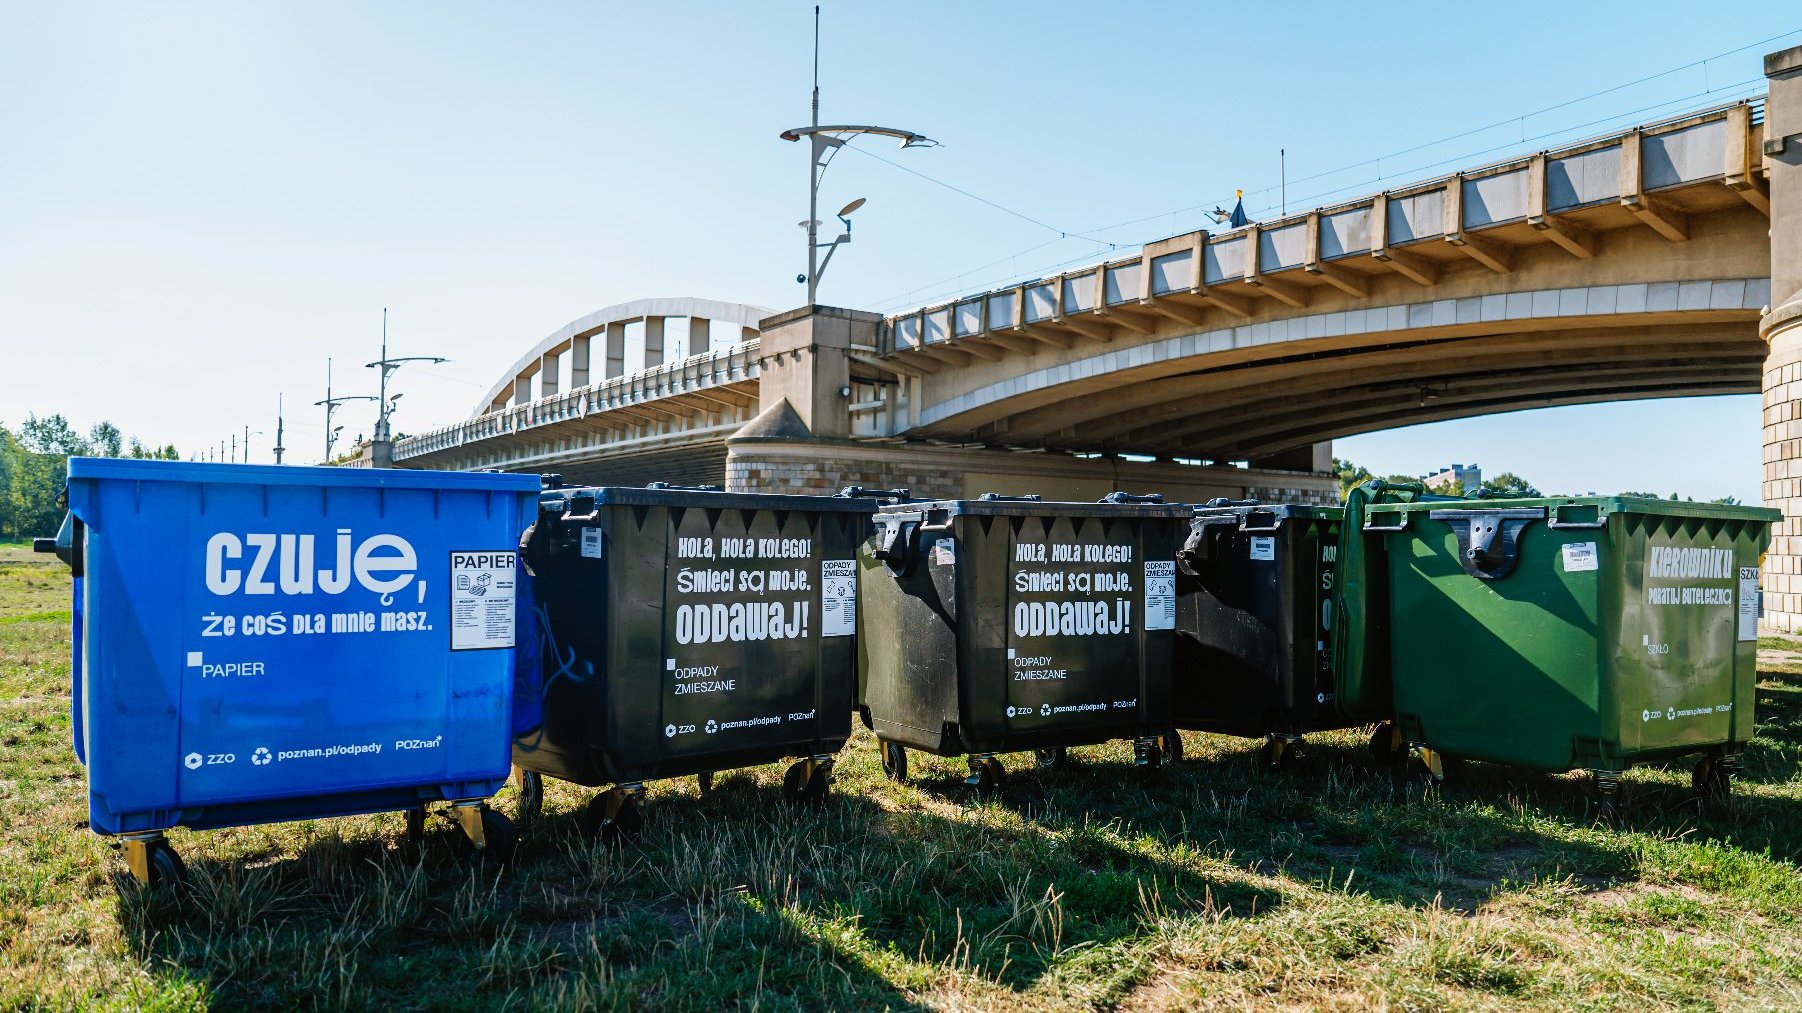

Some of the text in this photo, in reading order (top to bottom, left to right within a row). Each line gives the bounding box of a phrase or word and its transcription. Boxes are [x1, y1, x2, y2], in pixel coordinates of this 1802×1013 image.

[721, 538, 754, 558] HOLa
[1052, 544, 1081, 562] HOLa
[454, 555, 515, 569] PAPIER
[823, 561, 852, 570] ODPADY
[1145, 562, 1171, 570] ODPADY
[676, 567, 811, 596] Śmieci są moje.
[1014, 569, 1133, 596] Śmieci są moje.
[331, 611, 376, 634] mnie
[380, 611, 433, 632] masz.
[1647, 644, 1669, 655] SZKŁO
[1014, 656, 1052, 667] ODPADY
[202, 662, 265, 678] PAPIER
[674, 665, 719, 679] ODPADY
[1014, 669, 1067, 681] ZMIESZANE
[674, 679, 736, 695] ZMIESZANE
[1017, 707, 1033, 715] ZZO
[1053, 702, 1107, 713] poznan.pl/odpady
[1650, 711, 1662, 719] ZZO
[678, 724, 696, 734] ZZO
[721, 715, 782, 731] poznan.pl/odpady
[206, 753, 236, 765] ZZO
[278, 742, 382, 762] poznan.pl/odpady
